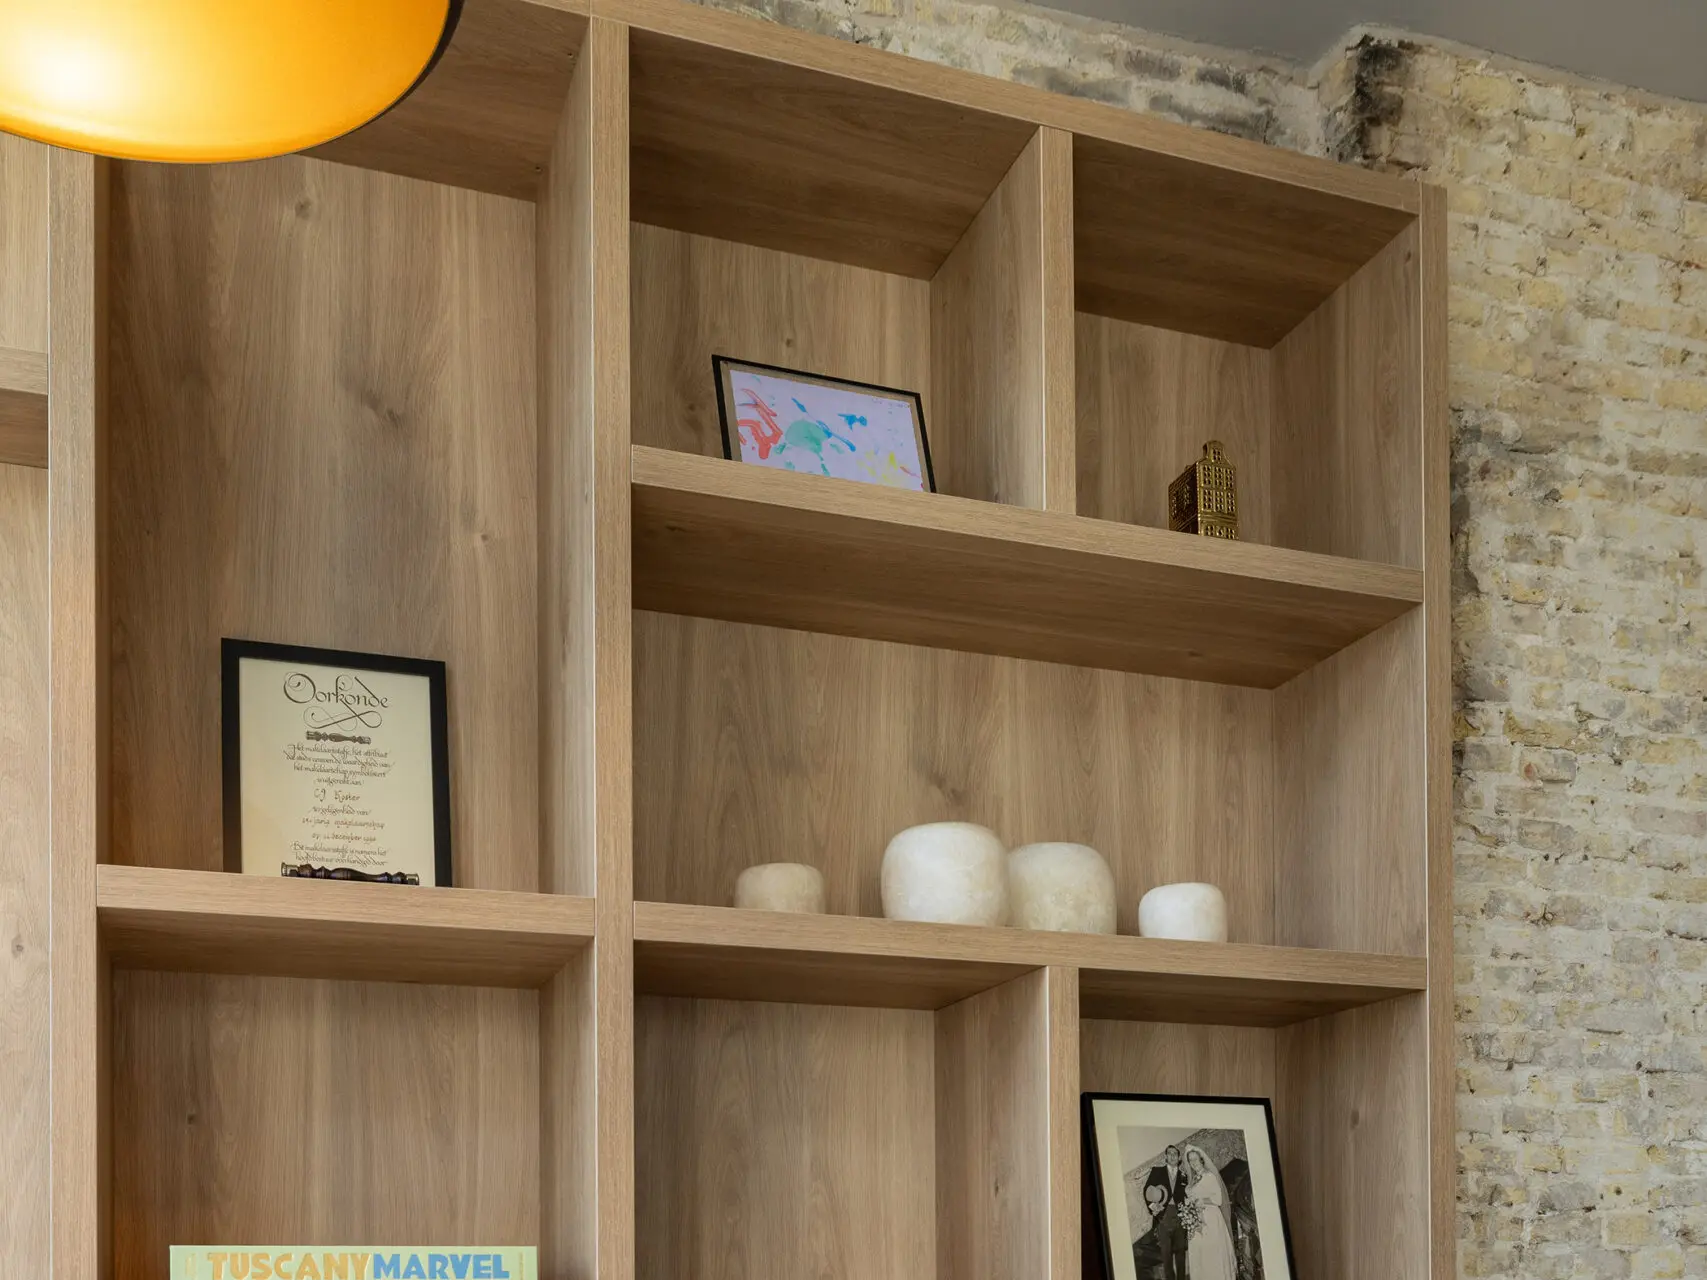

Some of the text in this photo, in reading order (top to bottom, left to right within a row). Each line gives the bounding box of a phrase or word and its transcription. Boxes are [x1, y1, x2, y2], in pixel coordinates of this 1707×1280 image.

[283, 672, 390, 709] Oorkonde
[207, 1252, 372, 1280] TUSCANY
[373, 1253, 510, 1280] MARVEL
